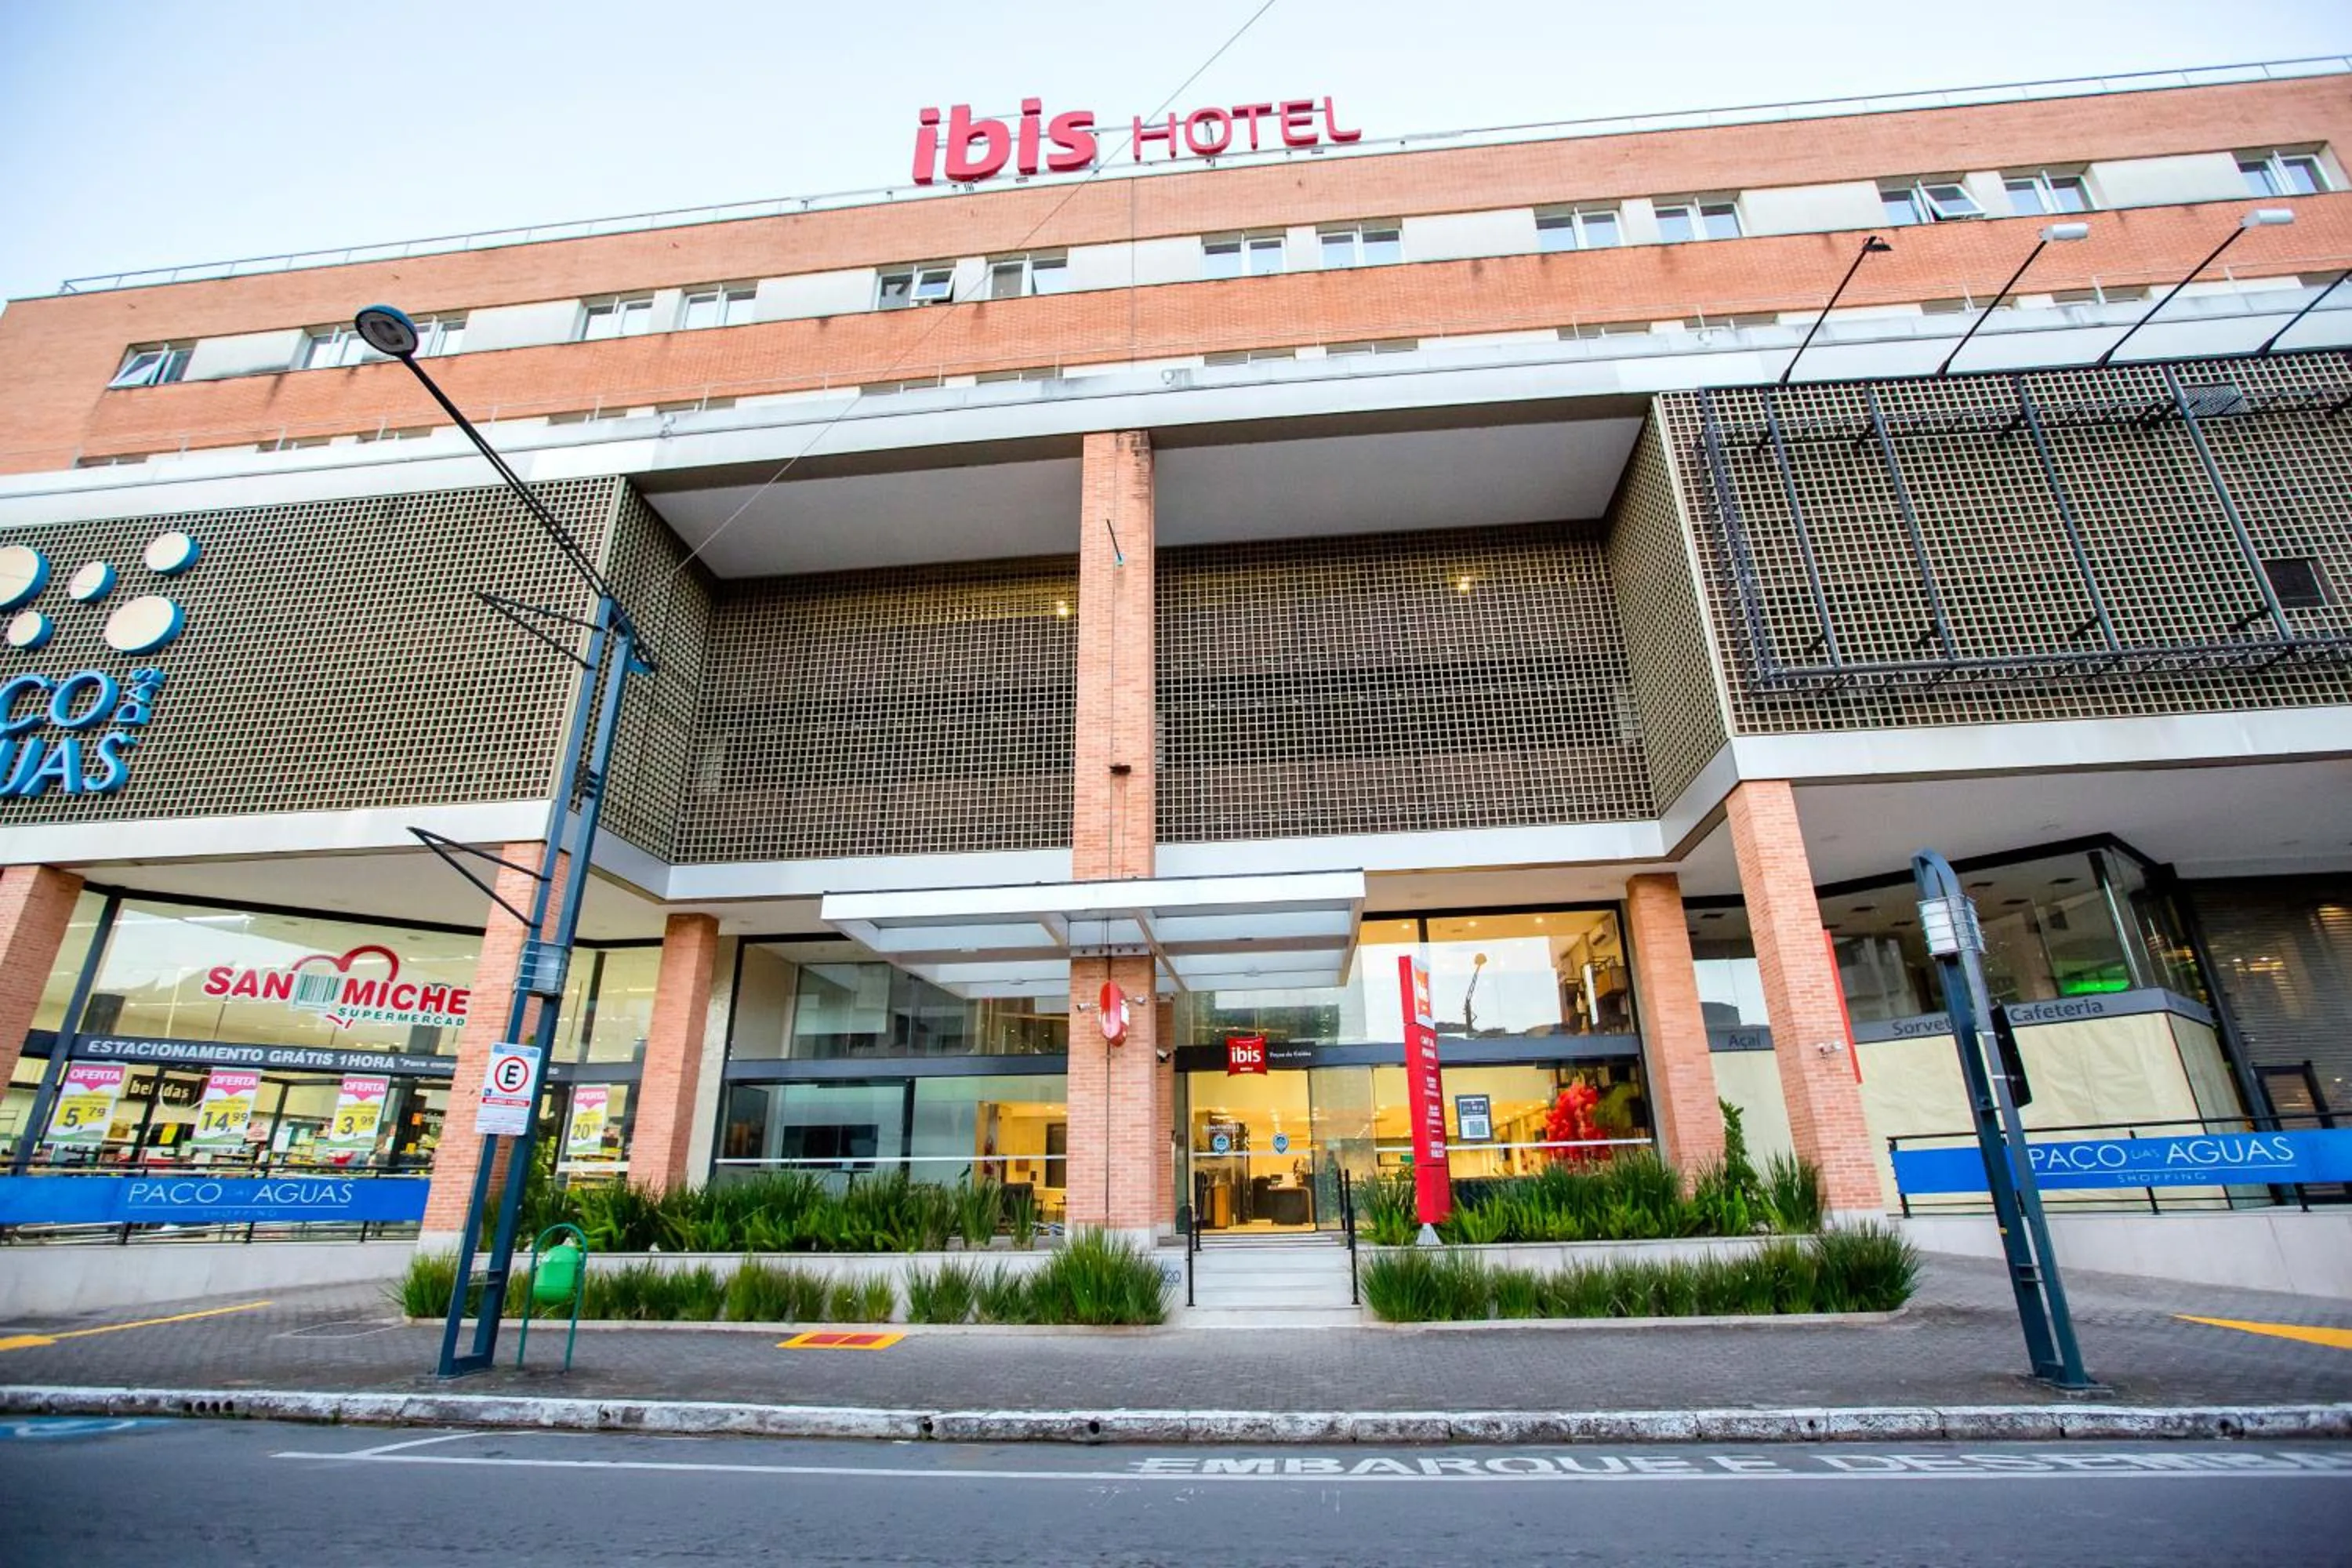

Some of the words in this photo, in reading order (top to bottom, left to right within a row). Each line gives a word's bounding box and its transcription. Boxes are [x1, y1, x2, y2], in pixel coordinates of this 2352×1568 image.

[912, 96, 1097, 185] ibis
[1132, 96, 1361, 162] HOTEL
[117, 666, 167, 725] DAS
[204, 965, 296, 1000] SAN
[341, 978, 471, 1015] MICHE
[337, 1007, 466, 1027] SUPERMERCAD
[2010, 998, 2105, 1023] Cafeteria
[87, 1040, 264, 1063] ESTACIONAMENTO
[269, 1048, 334, 1067] GRÁTIS
[1232, 1045, 1261, 1063] ibis
[70, 1069, 121, 1080] OFERTA
[209, 1075, 257, 1087] OFERTA
[503, 1065, 520, 1085] E
[343, 1082, 385, 1092] OFERTA
[2028, 1144, 2127, 1171] PAÇO
[2165, 1136, 2294, 1165] ÁGUAS
[1126, 1456, 1705, 1476] EMBARQUE
[1709, 1456, 1792, 1474] E
